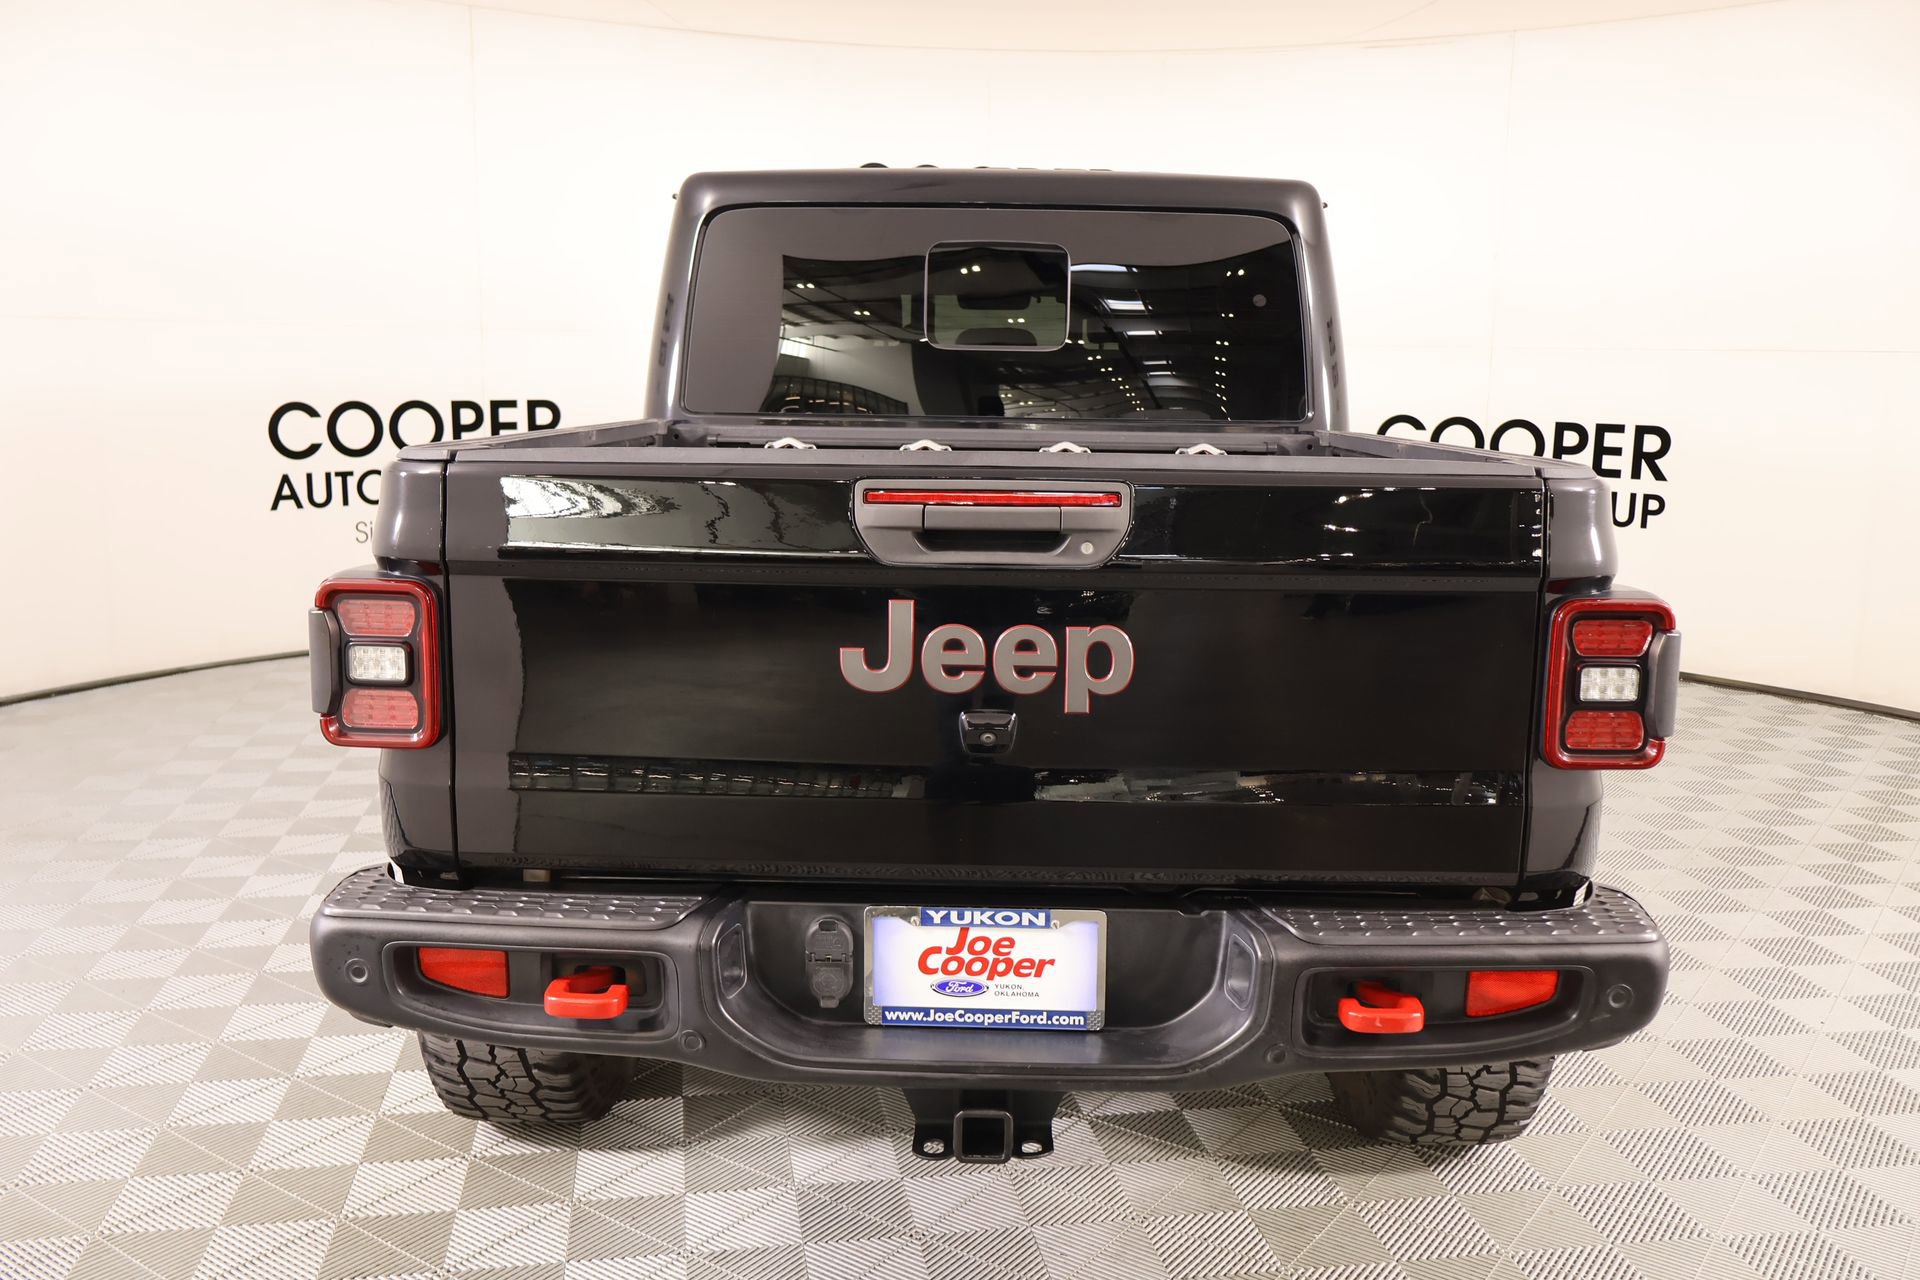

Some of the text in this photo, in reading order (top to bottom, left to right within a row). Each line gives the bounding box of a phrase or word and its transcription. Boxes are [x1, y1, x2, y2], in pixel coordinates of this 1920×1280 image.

[268, 400, 561, 460] COOPER
[840, 599, 1134, 714] Jeep
[926, 909, 1046, 926] YUKON
[945, 927, 1016, 957] Joe
[918, 946, 1056, 981] Cooper
[945, 980, 975, 993] Ford
[994, 990, 1040, 998] OKLAHOMA
[884, 1009, 1085, 1027] www.JoeCooperFord.com
